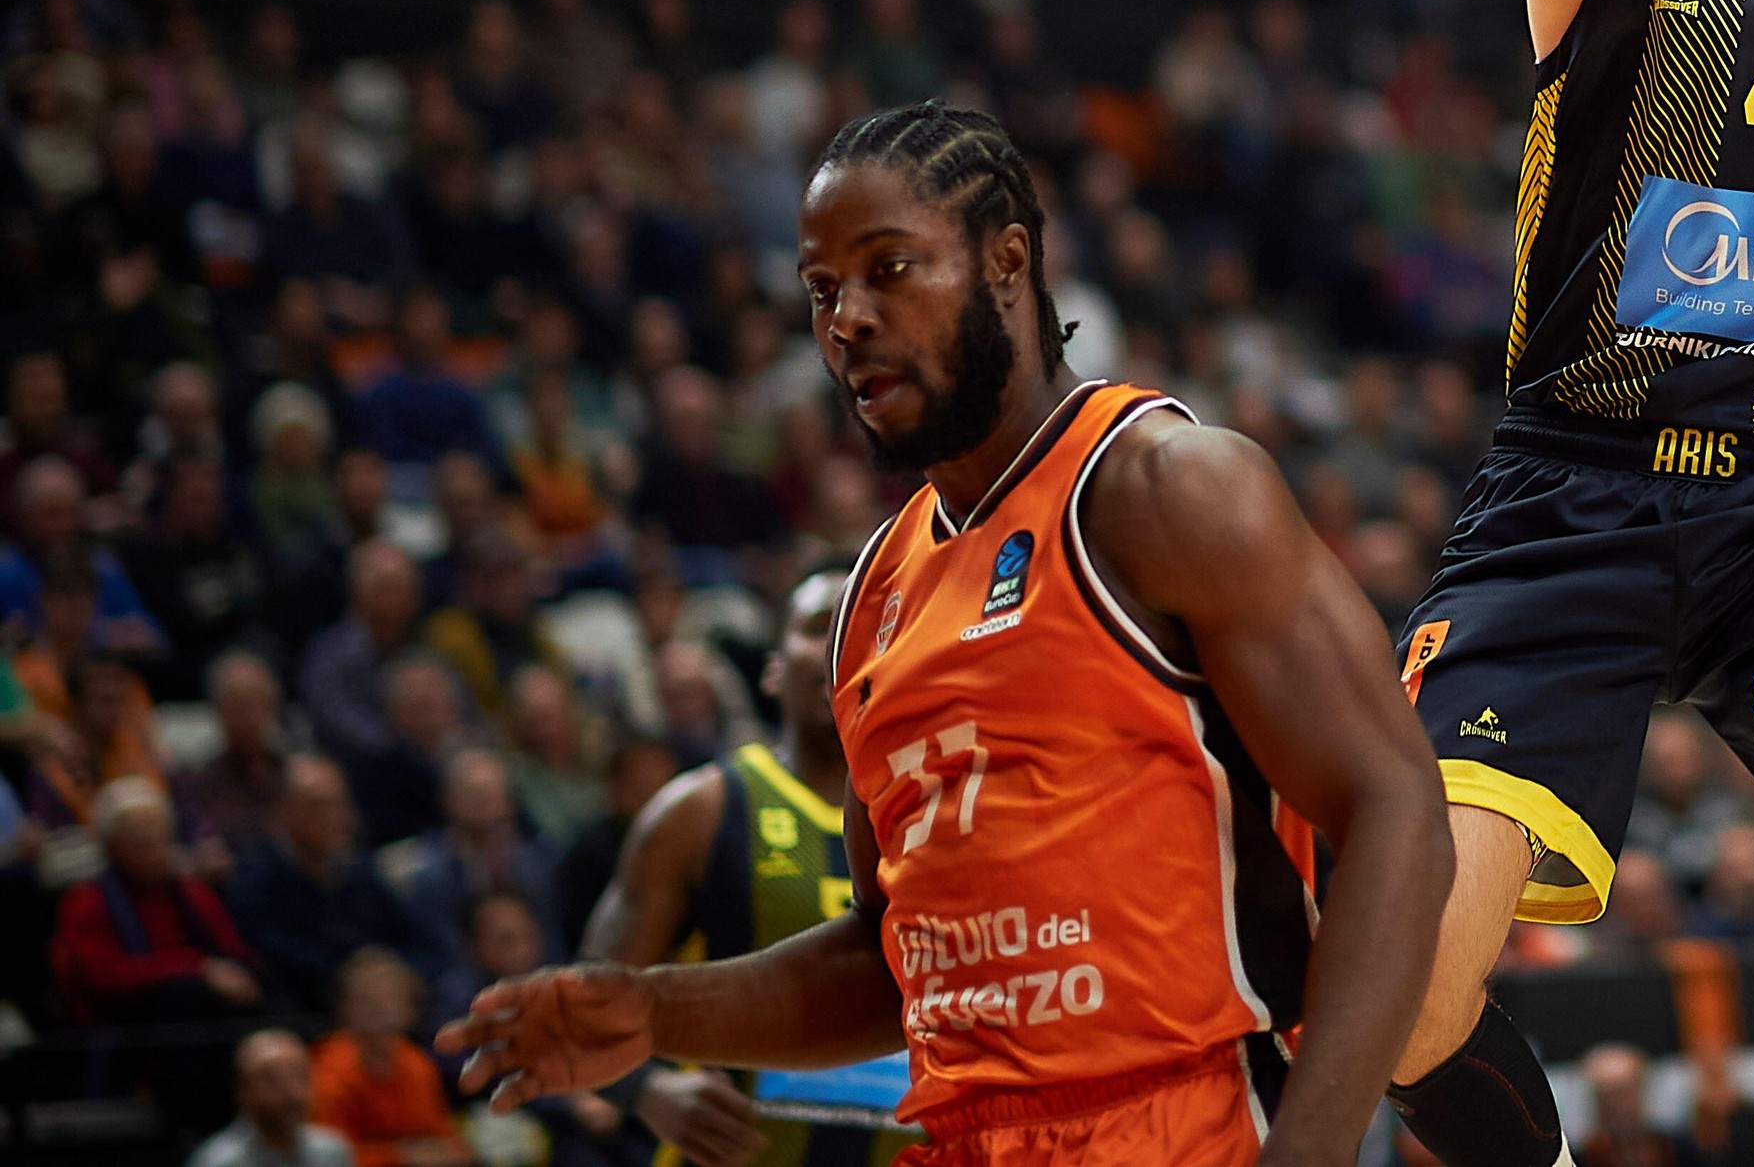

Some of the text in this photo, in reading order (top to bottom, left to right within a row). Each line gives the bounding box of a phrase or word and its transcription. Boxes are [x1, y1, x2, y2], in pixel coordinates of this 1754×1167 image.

[1655, 287, 1726, 315] Building
[1653, 428, 1739, 477] ARIS
[886, 720, 989, 855] 37
[892, 906, 1090, 979] ultura del
